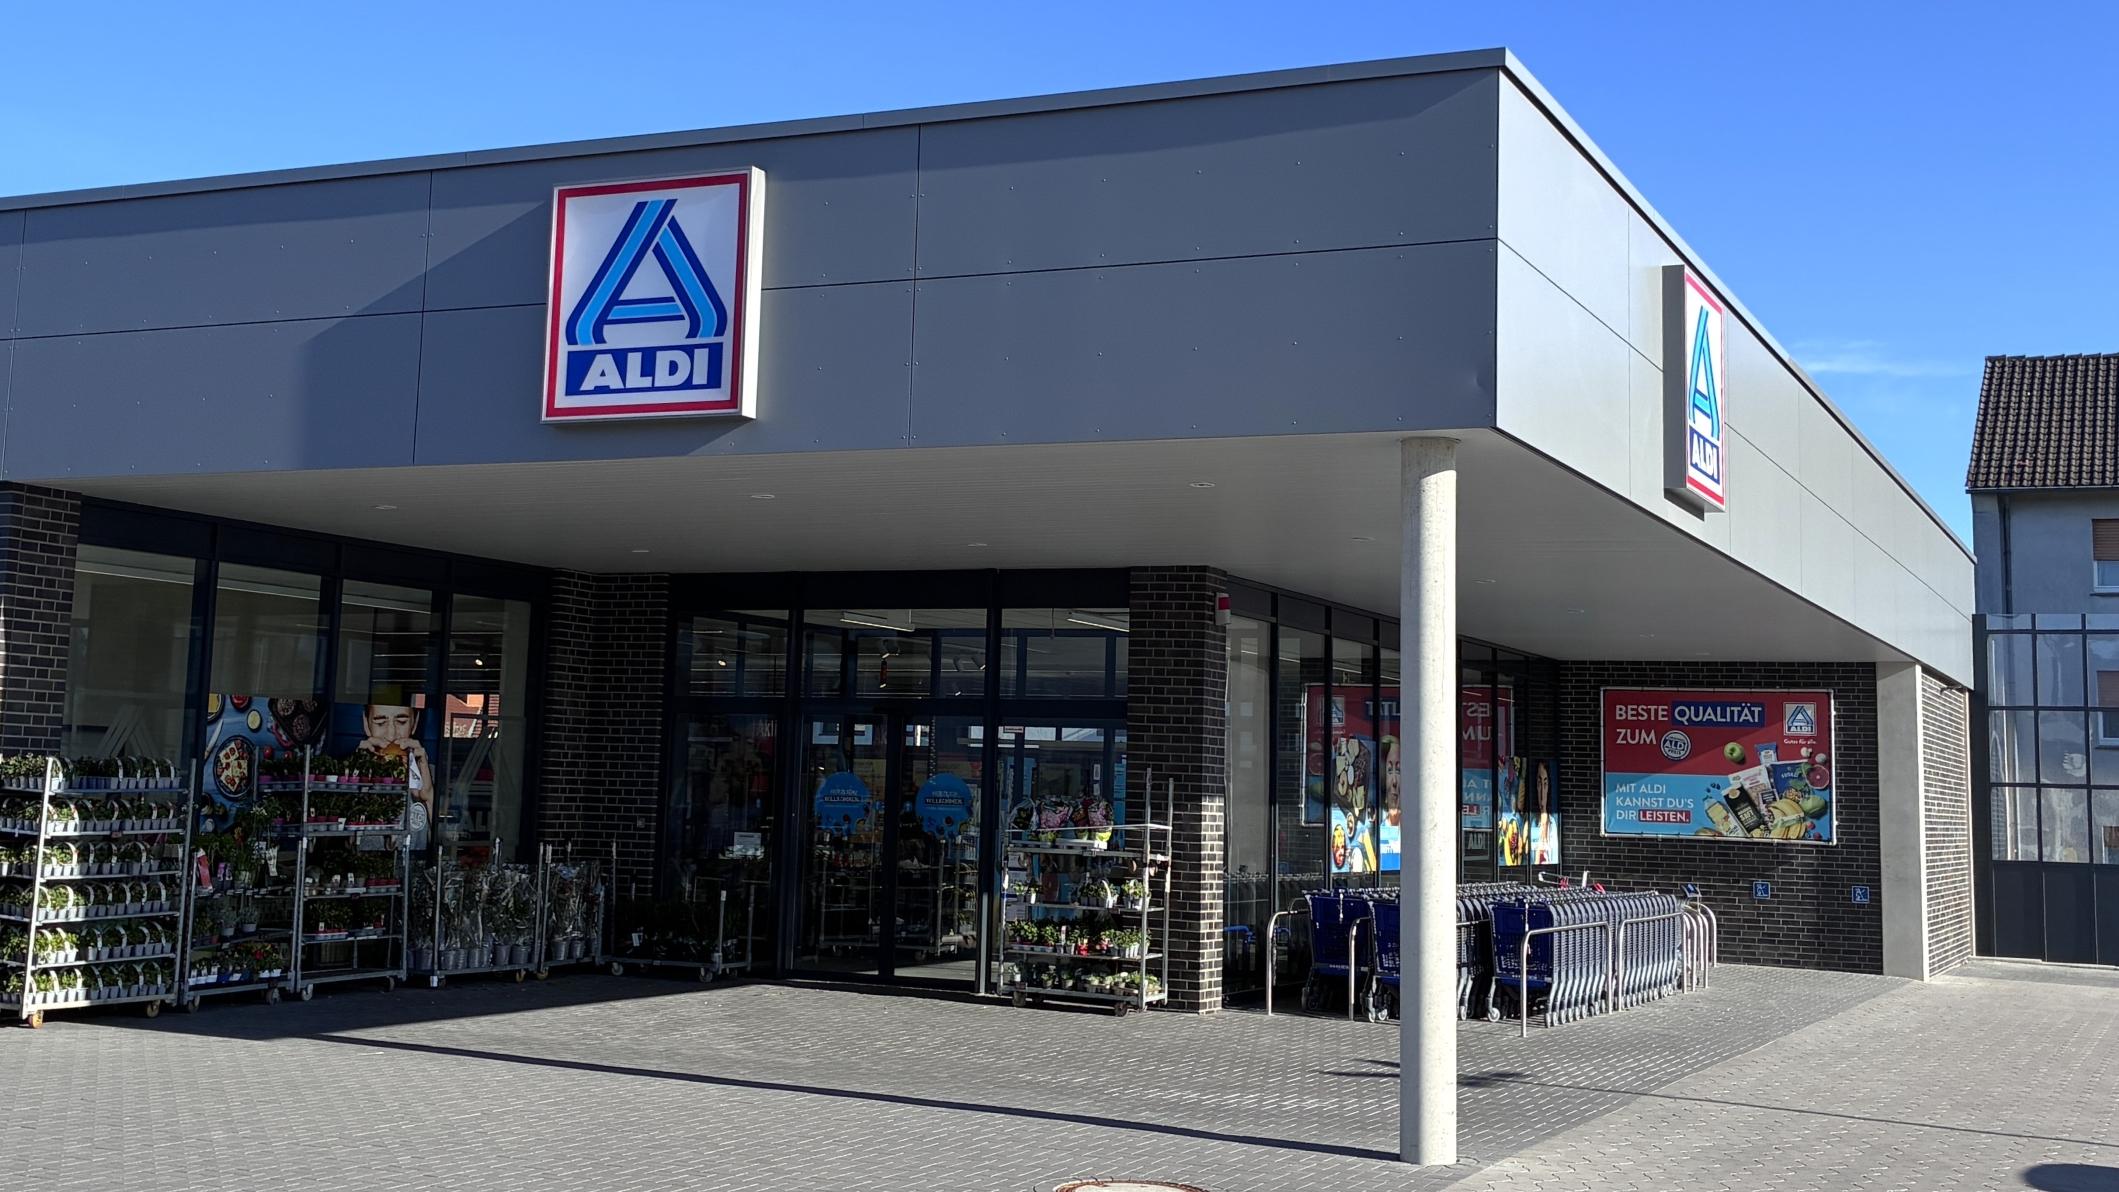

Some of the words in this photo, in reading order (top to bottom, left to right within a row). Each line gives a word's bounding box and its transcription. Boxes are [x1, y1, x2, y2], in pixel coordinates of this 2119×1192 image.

[579, 348, 709, 391] ALDI
[1691, 432, 1718, 480] ALDI
[1615, 704, 1669, 721] BESTE
[1674, 703, 1762, 726] QUALITÄT
[1616, 728, 1657, 745] ZUM
[1615, 783, 1637, 793] MIT
[1639, 783, 1666, 794] ALDI
[1615, 797, 1664, 808] KANNST
[1667, 798, 1694, 809] DU'S
[1616, 810, 1637, 820] DIR
[1640, 811, 1689, 822] LEISTEN.
